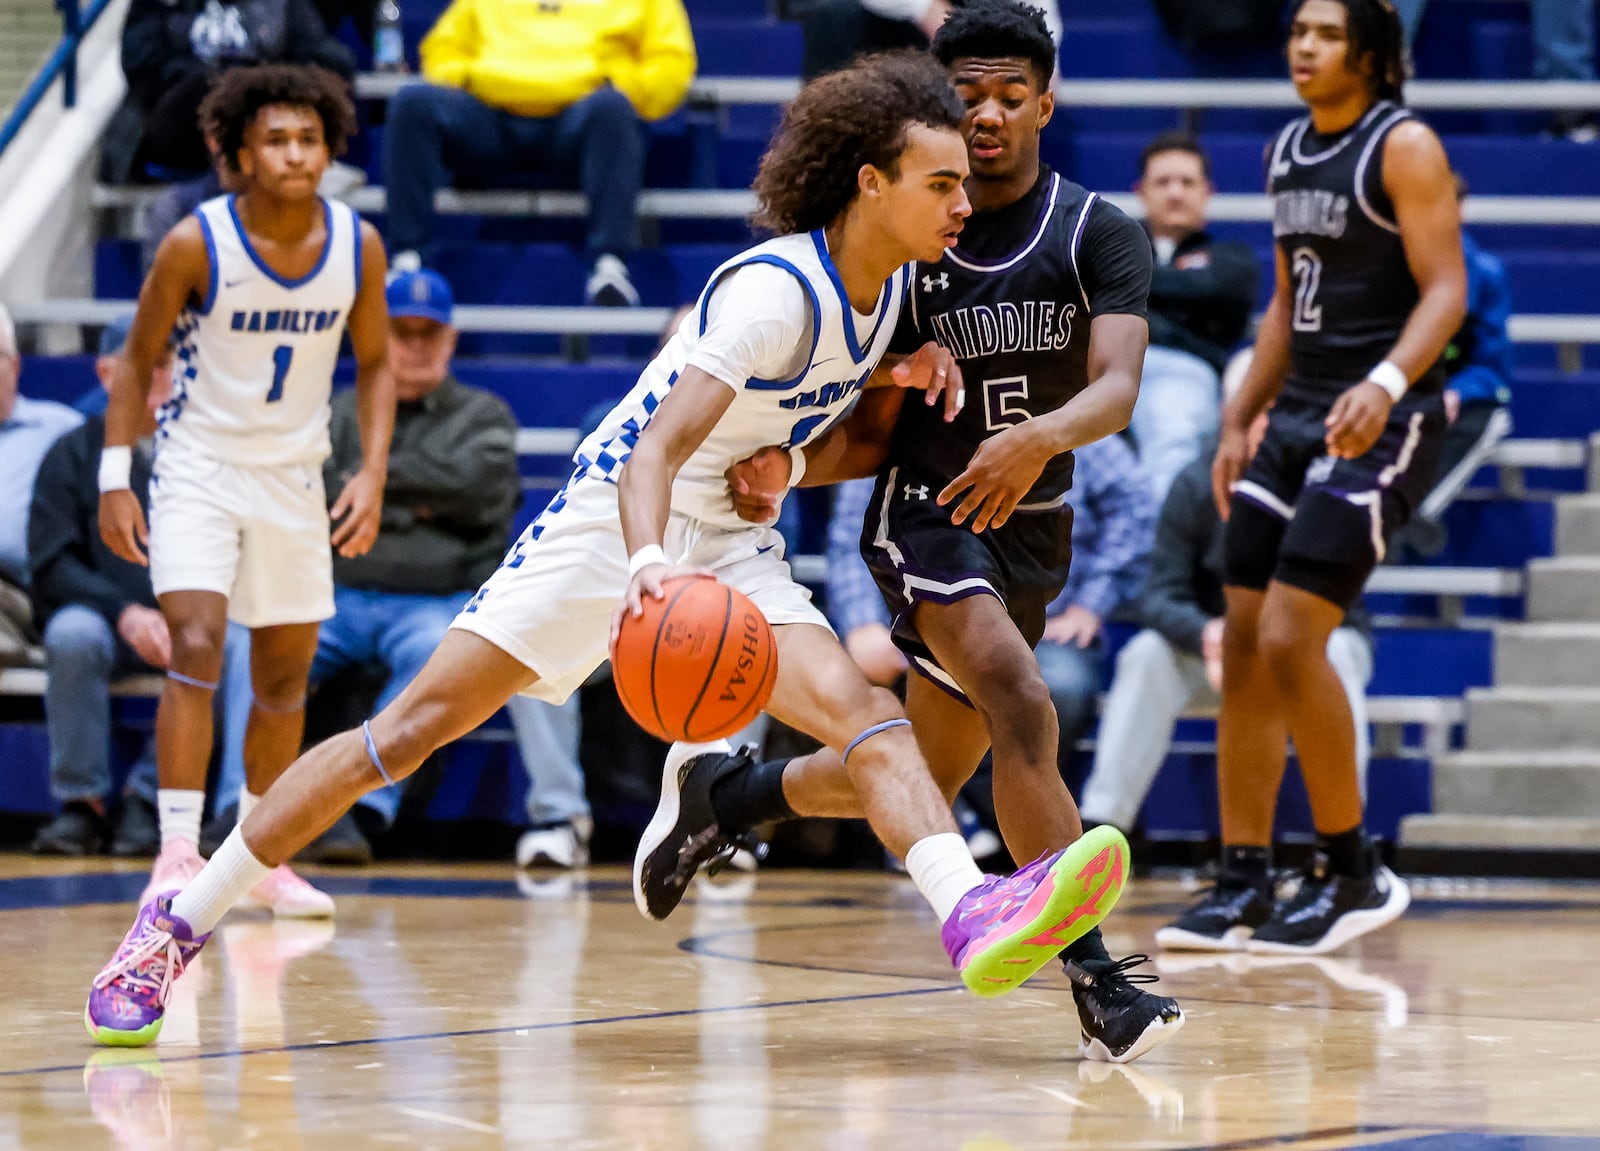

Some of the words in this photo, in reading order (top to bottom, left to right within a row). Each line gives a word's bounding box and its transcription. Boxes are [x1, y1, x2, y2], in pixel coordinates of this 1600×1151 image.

[1293, 248, 1321, 331] 2
[930, 301, 1077, 360] MIDDIES
[266, 345, 293, 402] 1
[982, 375, 1034, 432] 5
[719, 613, 759, 702] OHSAA
